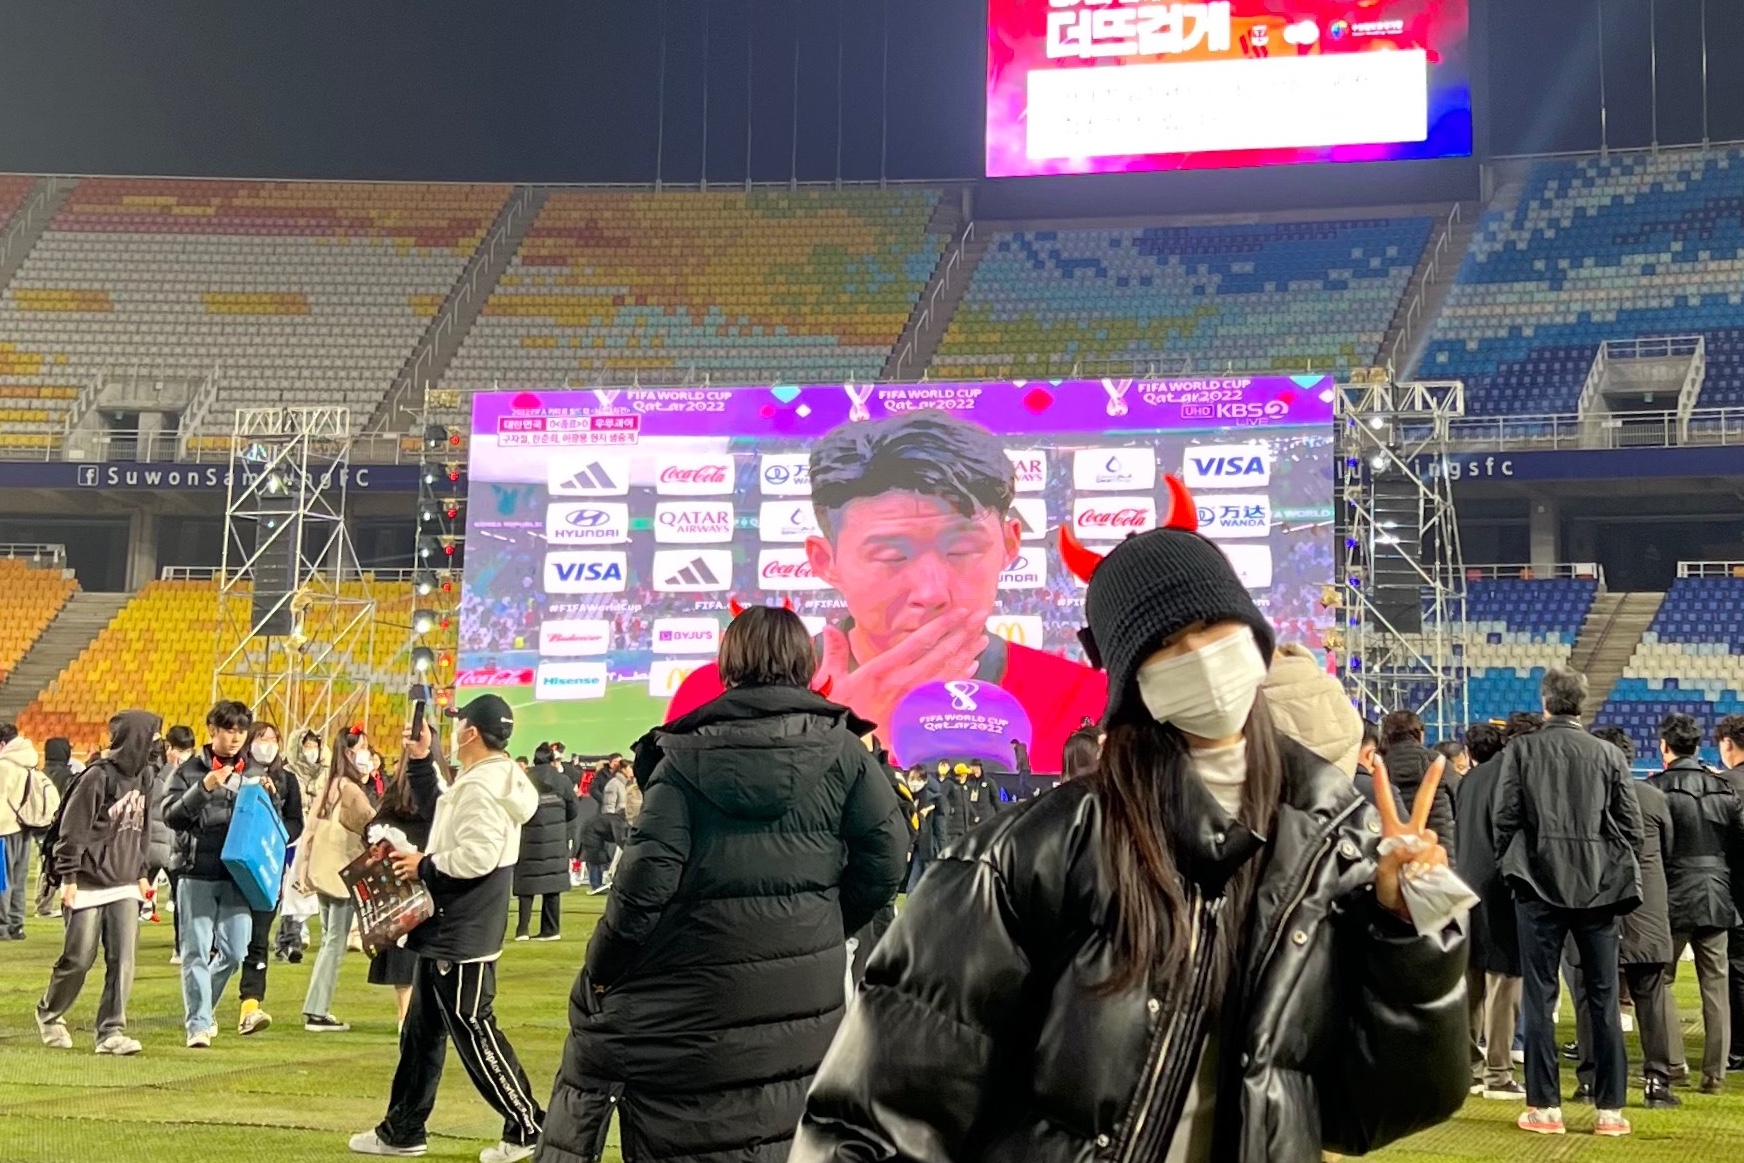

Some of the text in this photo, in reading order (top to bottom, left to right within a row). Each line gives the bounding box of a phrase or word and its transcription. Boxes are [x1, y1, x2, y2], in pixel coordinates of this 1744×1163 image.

[1138, 379, 1251, 393] FIFA WORLD CUP
[627, 391, 732, 400] FIFA WORLD CUP
[878, 388, 982, 399] FIFA WORLD CUP
[1184, 406, 1211, 416] UHD
[1236, 418, 1269, 426] LIVE
[1189, 456, 1265, 476] VISA
[660, 465, 730, 483] Coca-Cola
[1078, 508, 1150, 527] Coca-Cola
[1220, 505, 1266, 519] 万达
[659, 511, 729, 526] QATAR
[1220, 519, 1266, 527] WANDA
[555, 529, 619, 538] HYUNDAI
[677, 525, 730, 533] AIRWAYS
[551, 562, 622, 581] VISA
[762, 561, 816, 579] Coca-Co
[549, 600, 642, 612] #FIFAWorldCup
[674, 631, 713, 640] BYJU'S
[543, 677, 600, 686] Hisense
[919, 714, 1009, 726] FIFA WORLD CUP
